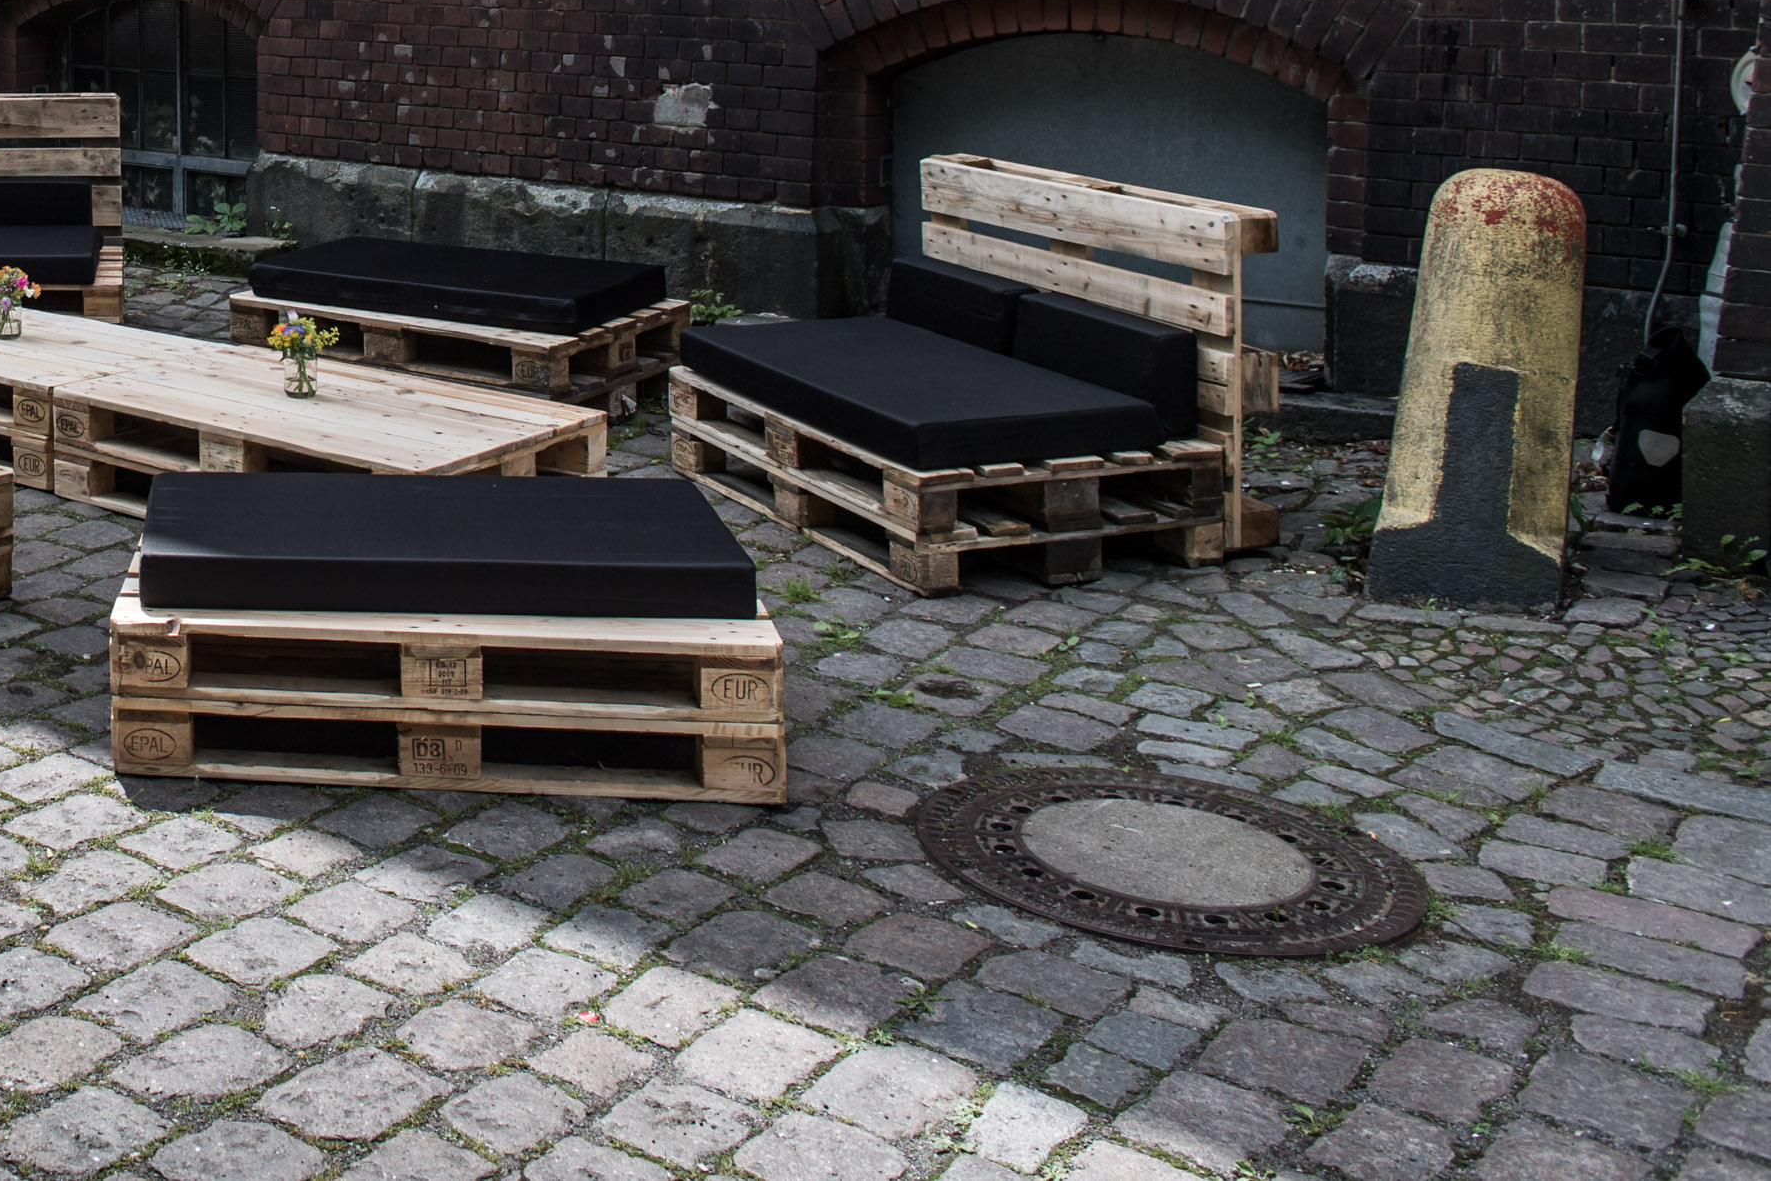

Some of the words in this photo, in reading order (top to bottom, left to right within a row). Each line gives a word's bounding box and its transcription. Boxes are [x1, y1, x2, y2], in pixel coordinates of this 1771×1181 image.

[21, 403, 41, 418] EPAL
[60, 418, 80, 434] EPAL
[23, 457, 40, 474] EUR
[144, 657, 173, 676] PAL
[723, 679, 758, 701] EUR
[130, 736, 169, 755] EPAL
